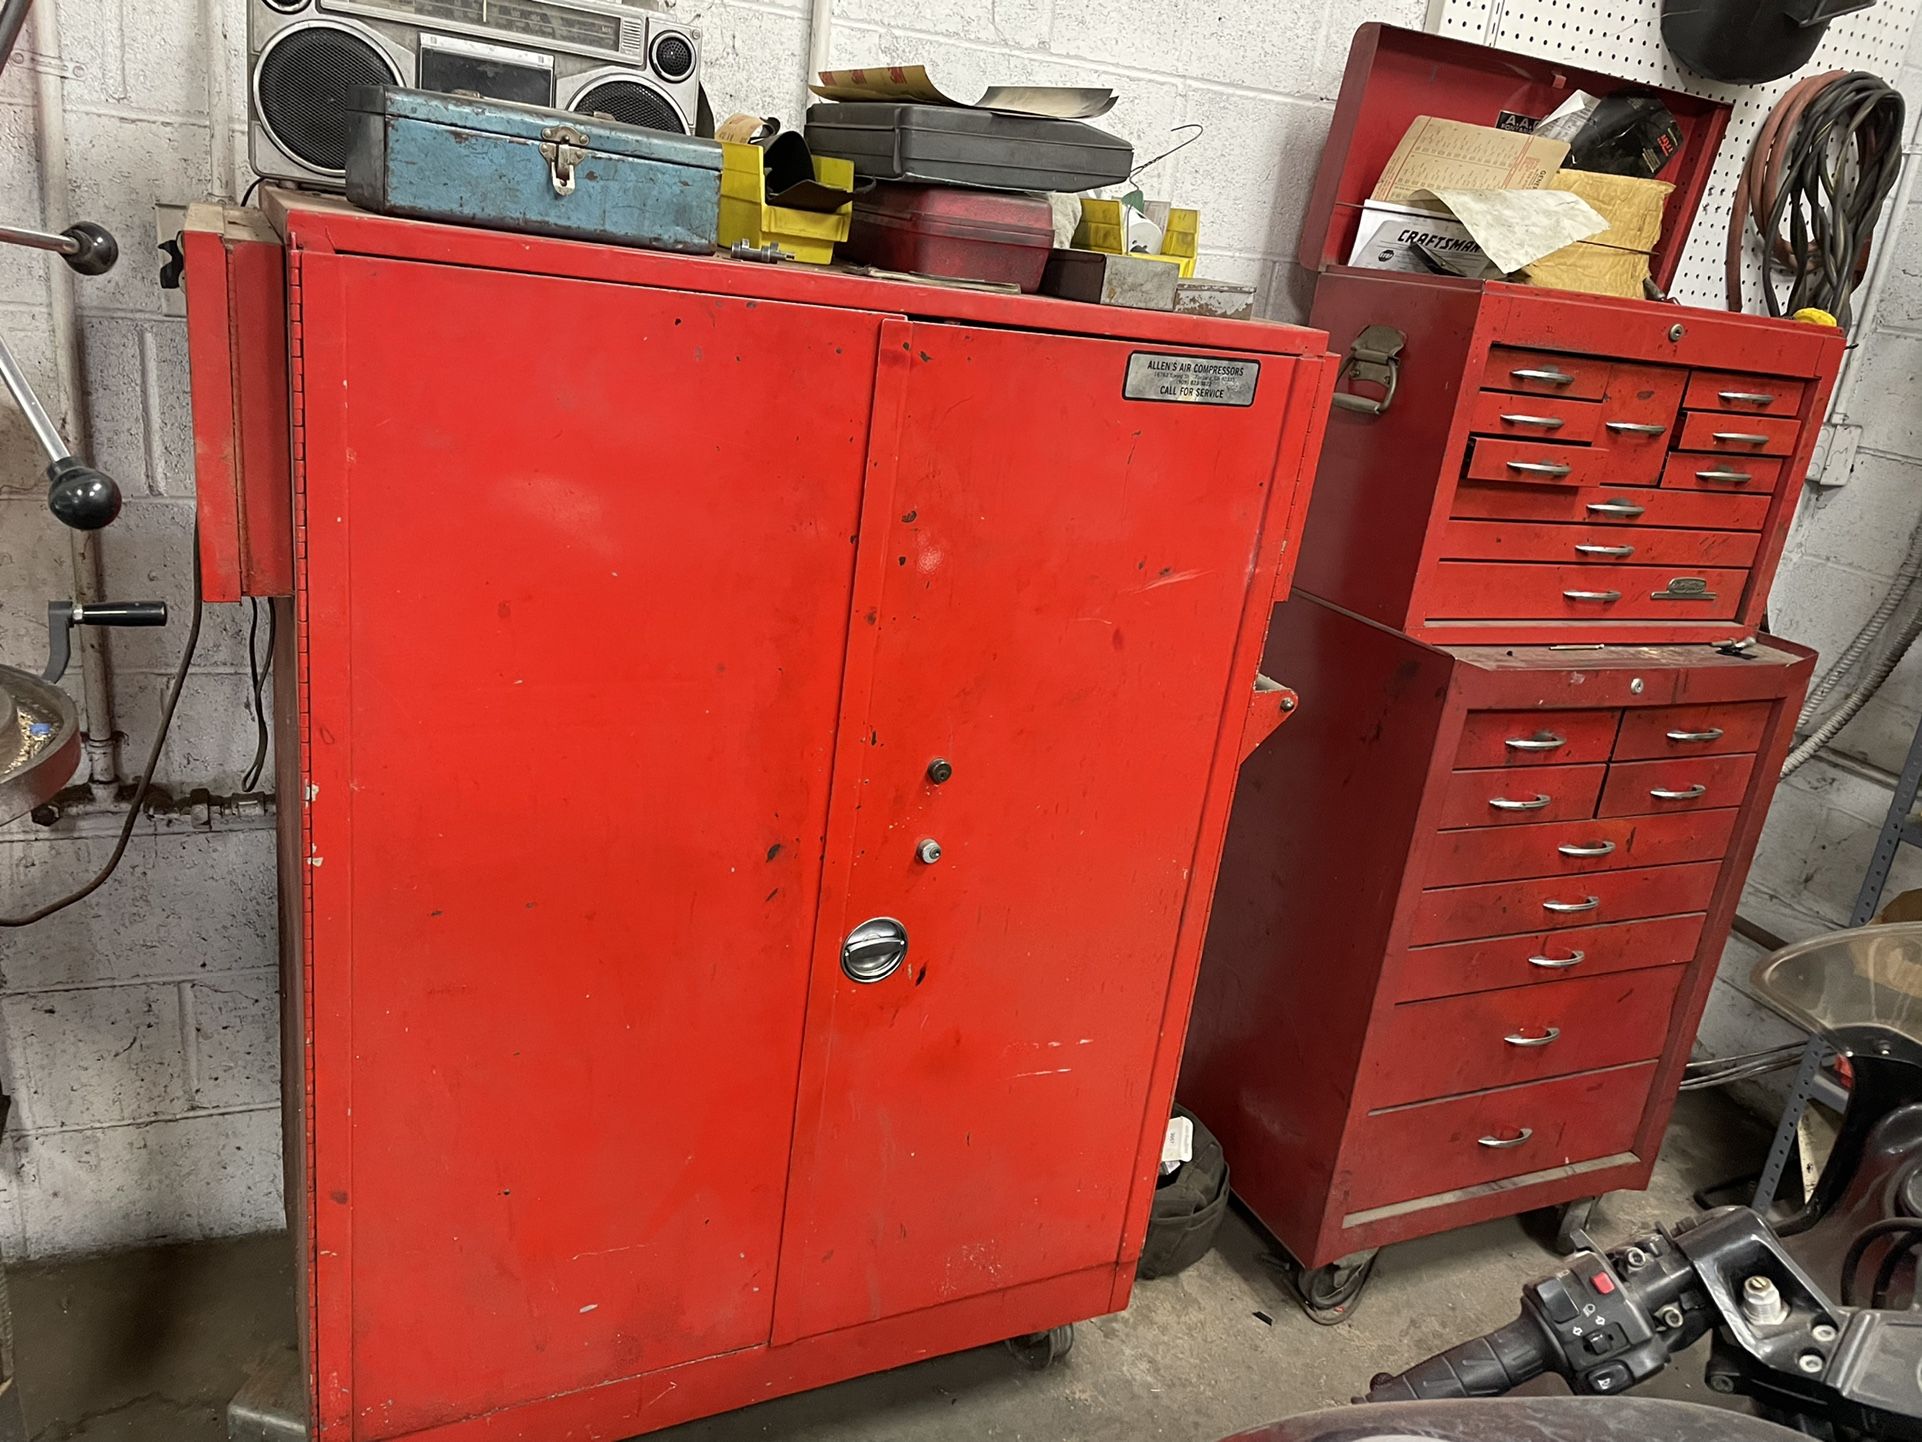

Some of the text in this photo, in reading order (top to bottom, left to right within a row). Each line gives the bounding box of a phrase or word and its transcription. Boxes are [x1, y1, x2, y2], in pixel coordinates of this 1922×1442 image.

[1397, 229, 1481, 253] CRAFTSMAN
[1147, 360, 1177, 371] ALLEN'S
[1179, 363, 1192, 373] AIR
[1193, 363, 1244, 376] COMPRESSORS
[1160, 385, 1224, 399] CALL FOR SERVICE
